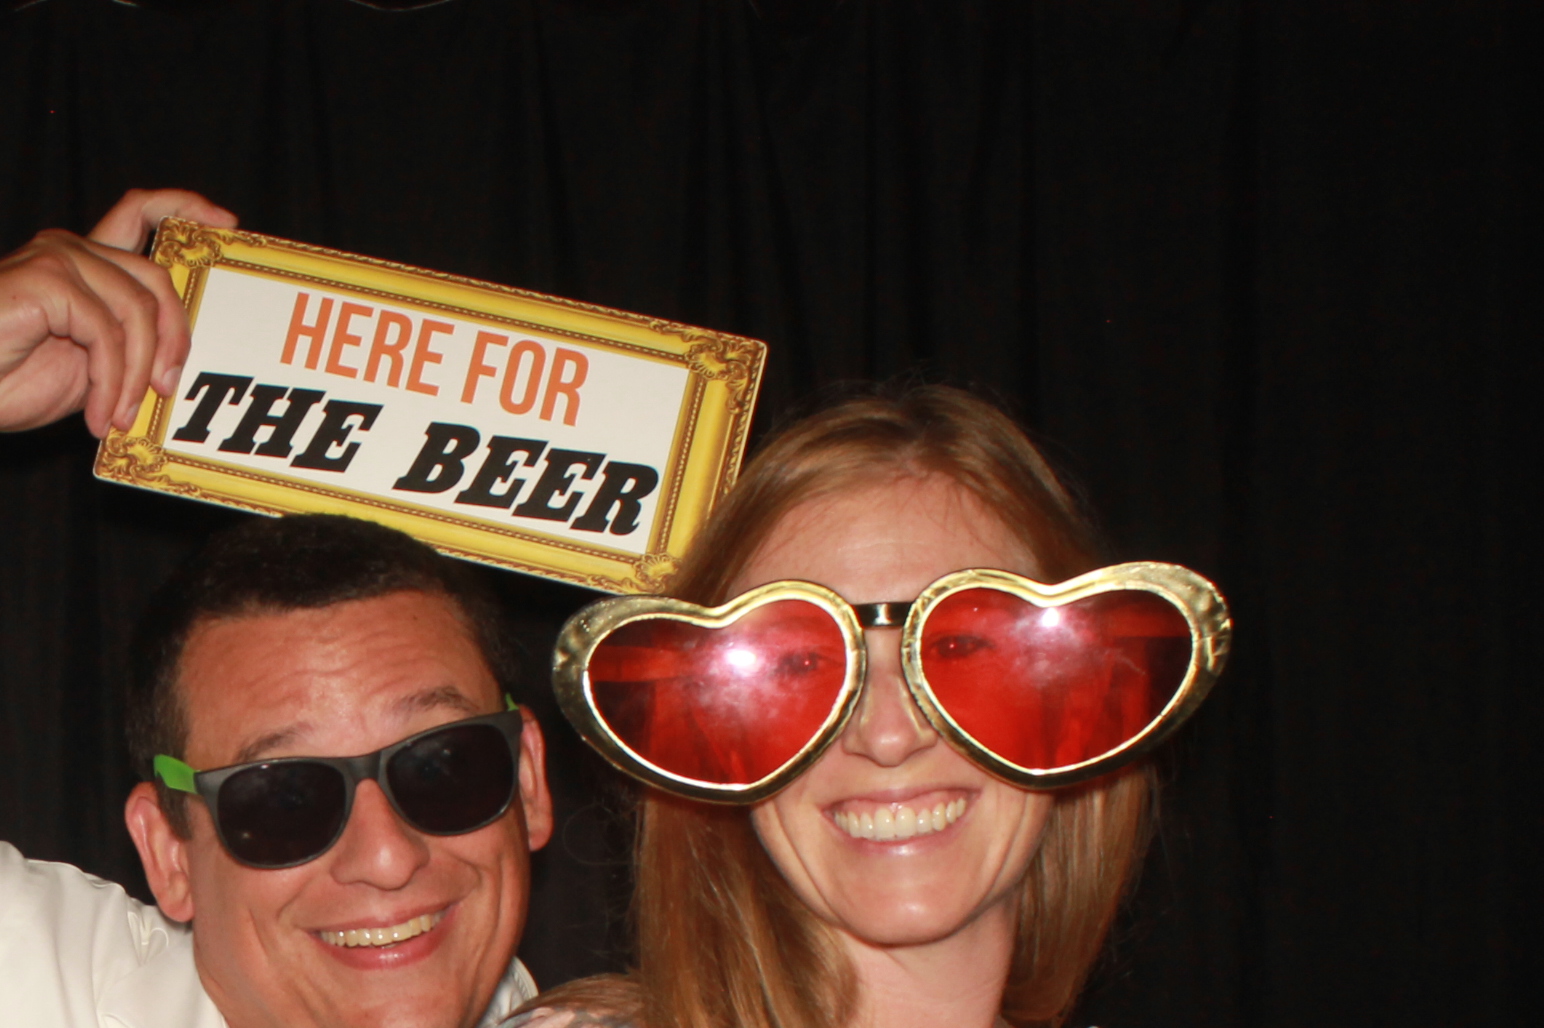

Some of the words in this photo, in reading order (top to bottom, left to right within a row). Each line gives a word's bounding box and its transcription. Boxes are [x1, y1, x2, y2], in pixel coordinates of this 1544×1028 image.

[280, 292, 454, 396] HERE
[460, 330, 589, 426] FOR
[172, 372, 383, 473] THE
[392, 421, 659, 535] BEER
